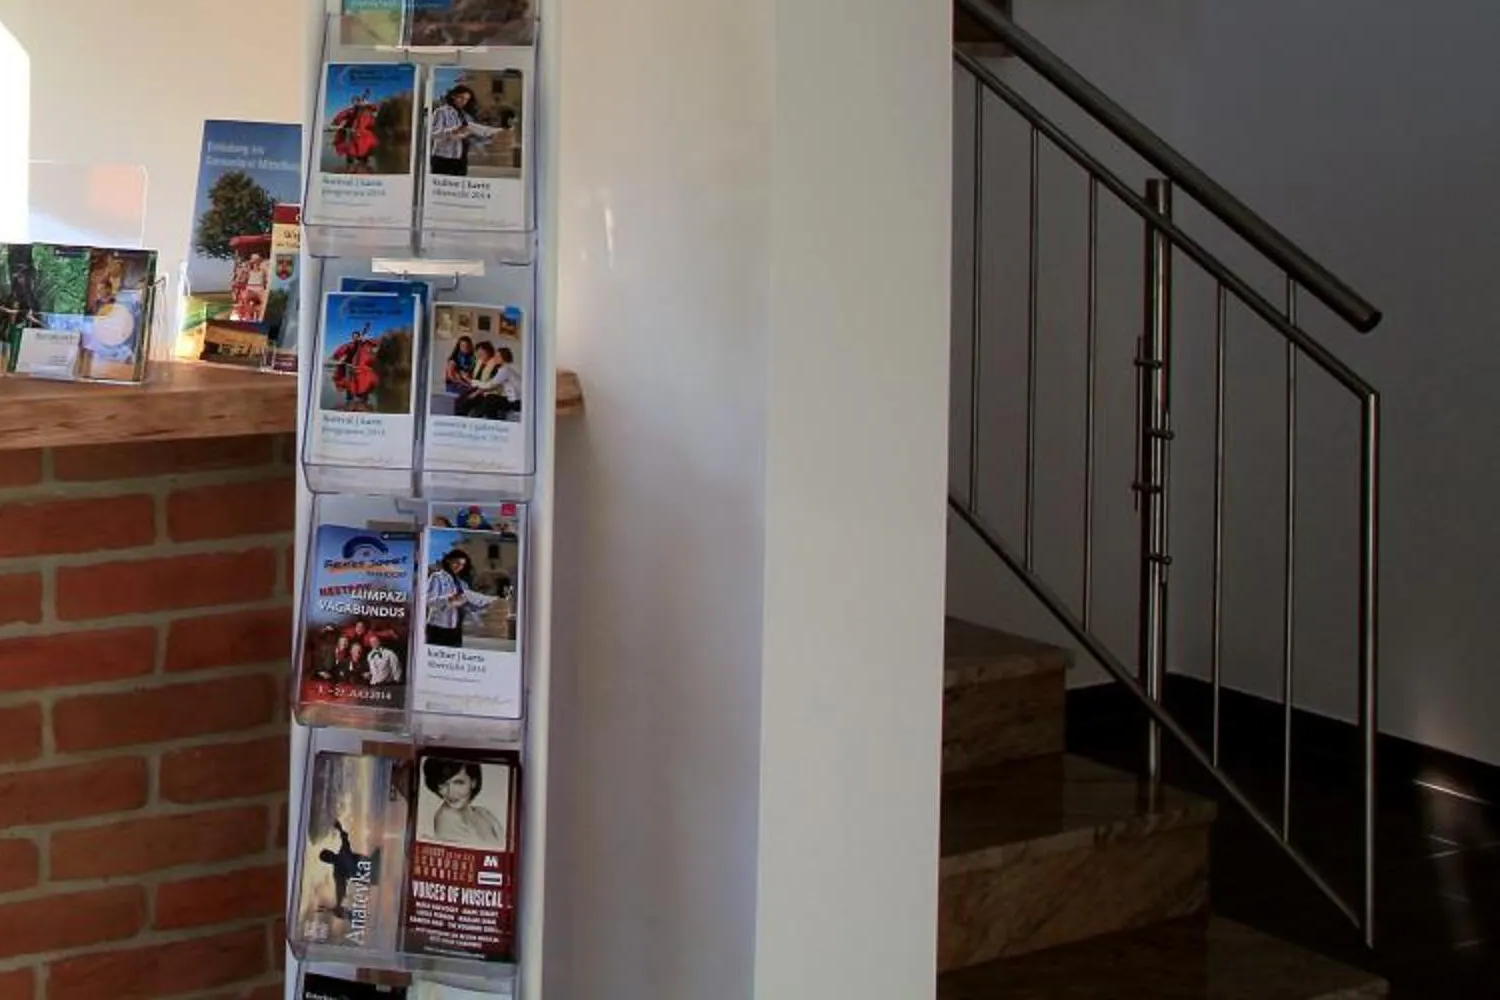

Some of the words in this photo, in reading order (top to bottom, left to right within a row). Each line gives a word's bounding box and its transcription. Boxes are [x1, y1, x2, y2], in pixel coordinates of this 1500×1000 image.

[319, 599, 406, 618] VAGABUNDUS
[345, 859, 372, 946] Anatevka
[412, 881, 447, 902] VOICES
[447, 885, 460, 904] OF
[461, 888, 503, 909] MUSICAL
